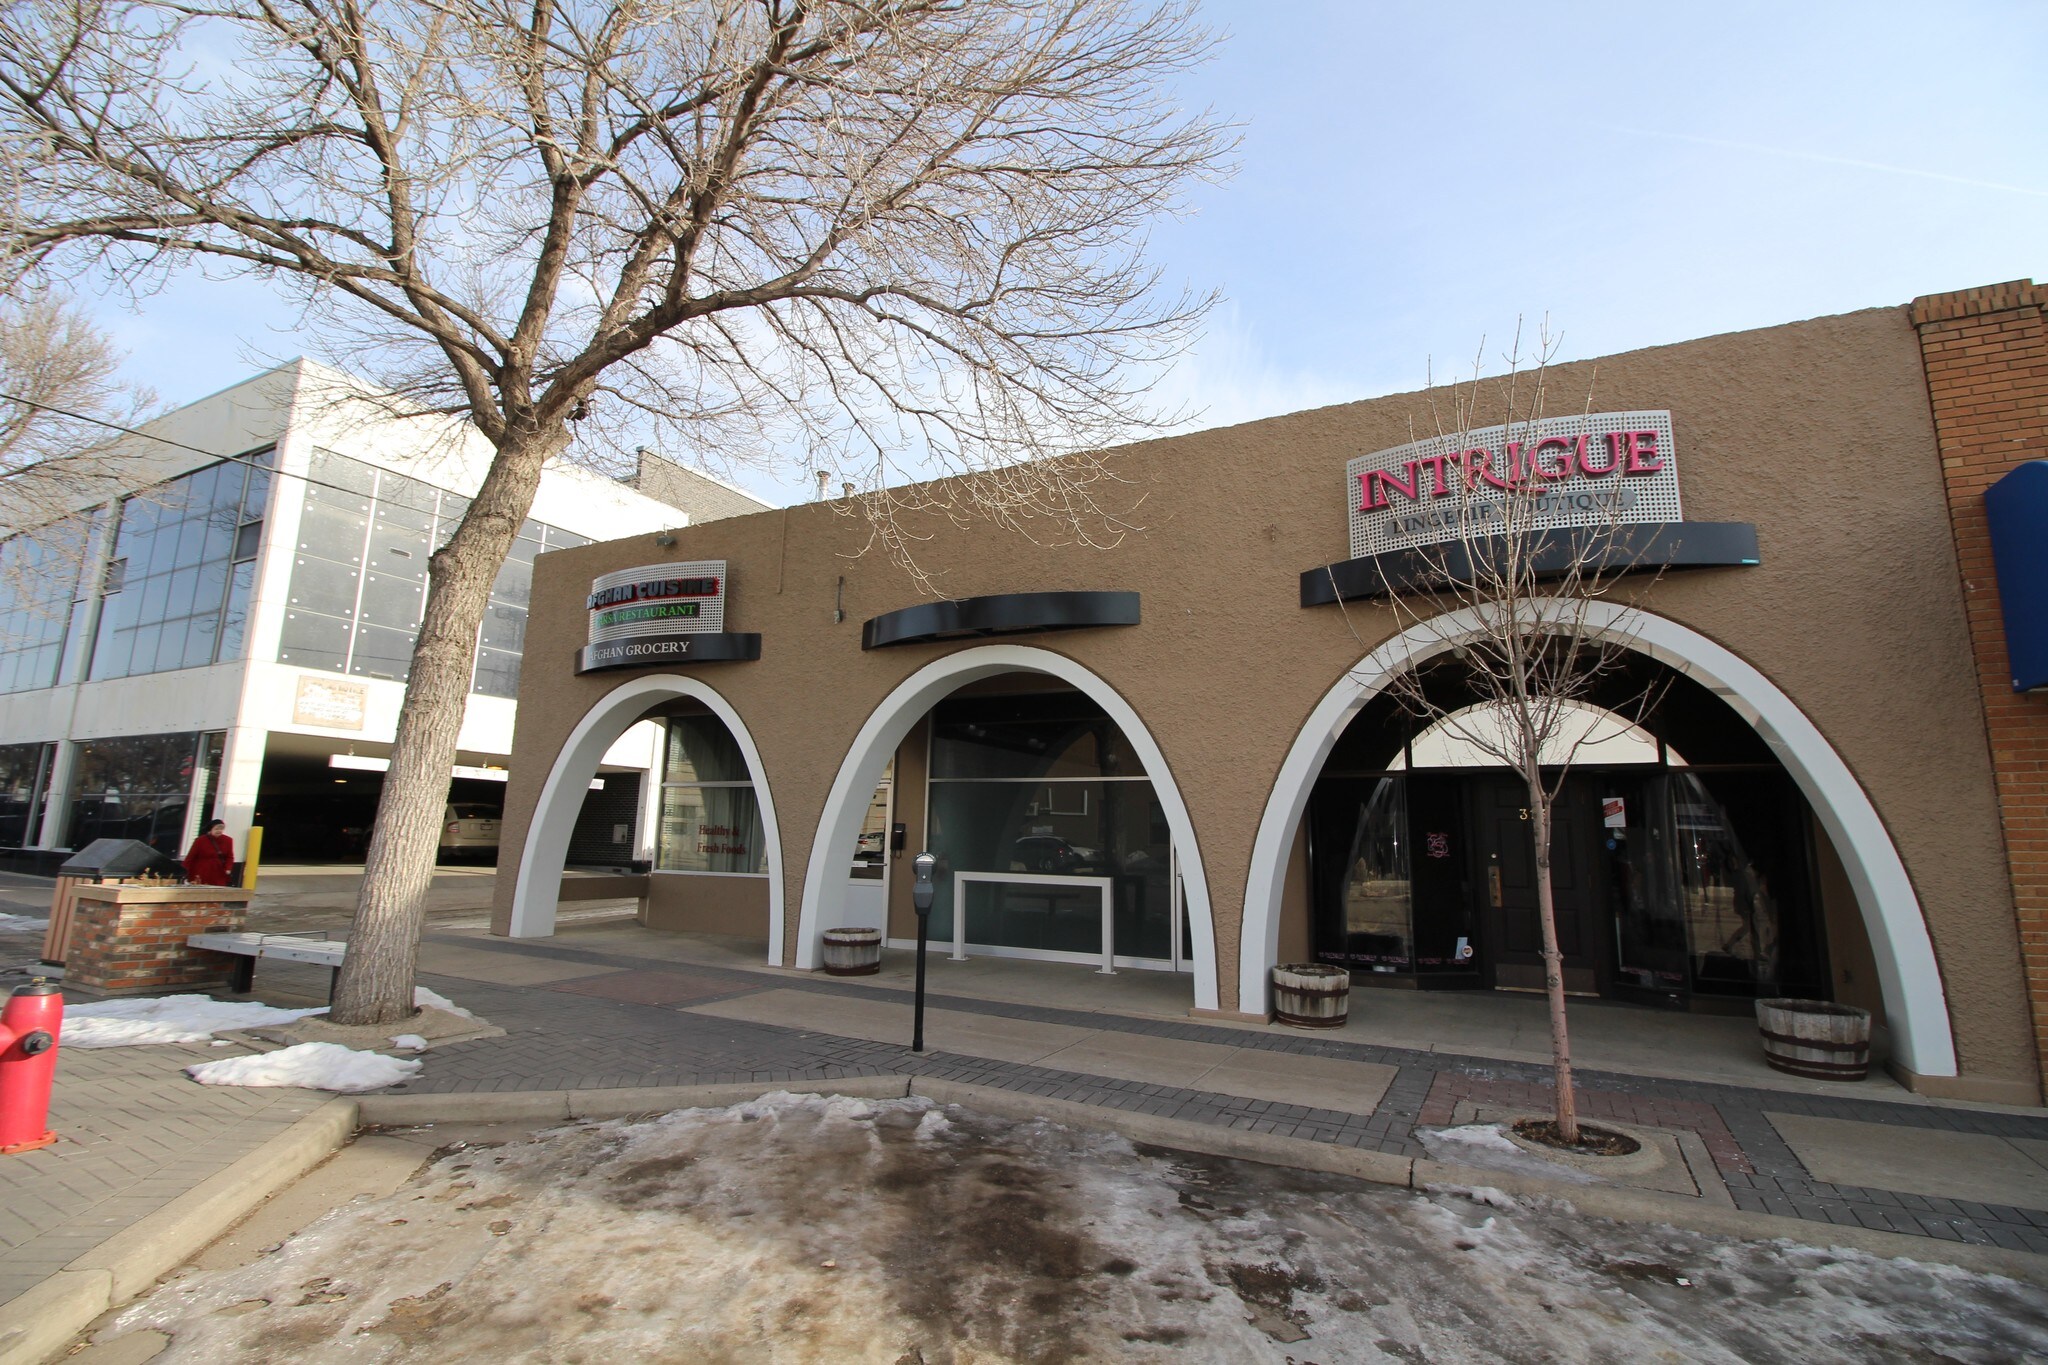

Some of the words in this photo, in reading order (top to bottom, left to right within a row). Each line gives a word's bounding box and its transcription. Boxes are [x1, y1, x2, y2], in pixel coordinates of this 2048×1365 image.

[1357, 430, 1664, 511] INTRIGUE
[587, 584, 633, 609] AFGHAN
[637, 577, 714, 598] CUISINE
[619, 604, 695, 621] RESTAURANT
[590, 645, 623, 660] AFGHAN
[626, 641, 690, 656] GROCERY
[699, 825, 730, 837] Healthy
[732, 827, 740, 836] &
[697, 842, 719, 853] Fresh
[721, 843, 746, 855] Foods
